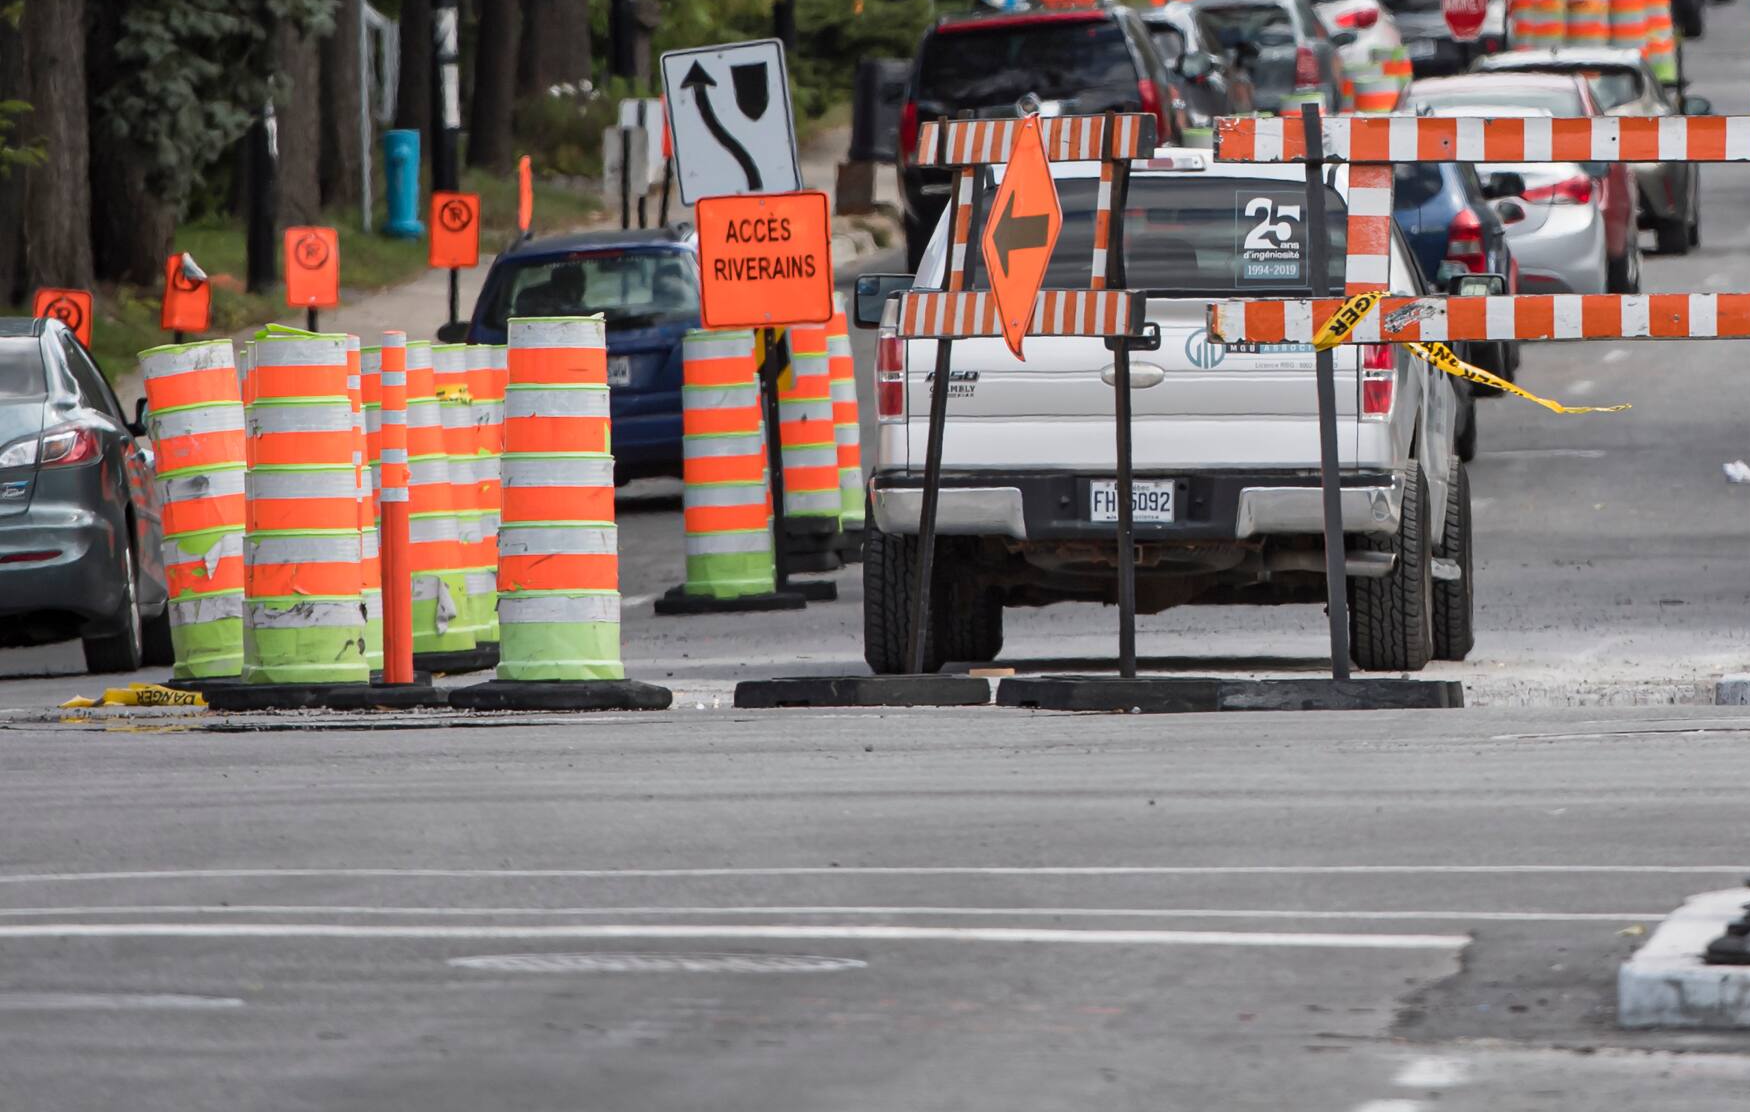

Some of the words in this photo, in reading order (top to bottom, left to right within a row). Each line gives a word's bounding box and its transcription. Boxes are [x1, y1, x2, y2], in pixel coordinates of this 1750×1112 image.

[725, 212, 792, 243] ACCÈS
[1244, 197, 1300, 248] 25
[1243, 250, 1300, 261] d'ingéniosité
[714, 254, 816, 281] RIVERAINS
[1247, 264, 1296, 276] 1994-2019
[1094, 491, 1170, 512] FH5092
[136, 690, 196, 705] DANGER
